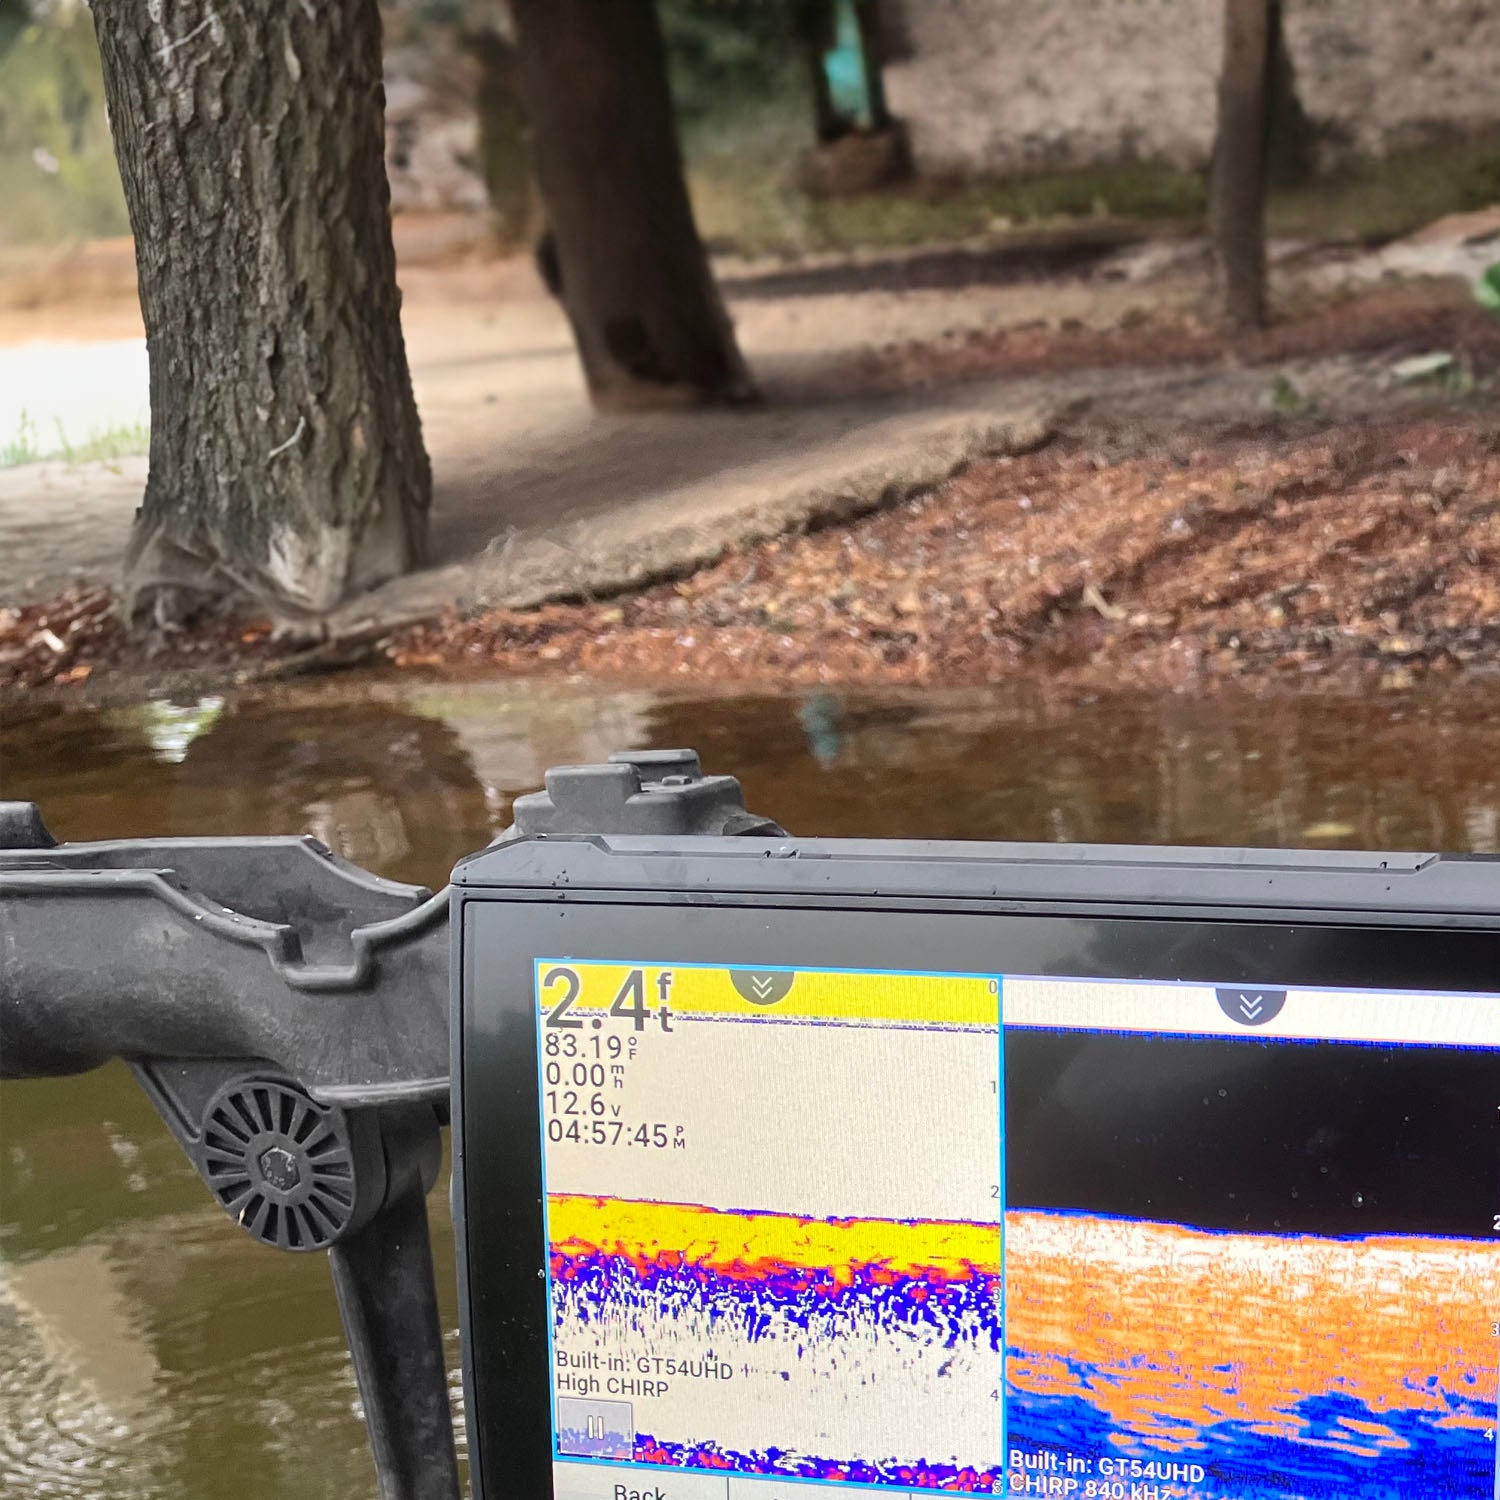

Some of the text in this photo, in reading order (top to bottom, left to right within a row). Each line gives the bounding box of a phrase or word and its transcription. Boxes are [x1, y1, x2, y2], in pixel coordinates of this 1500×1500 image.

[543, 966, 652, 1033] 2.4
[545, 1034, 622, 1060] 83.19
[546, 1062, 605, 1088] 0.00
[546, 1091, 605, 1116] 12.6
[548, 1119, 668, 1148] 04:57:45
[556, 1351, 733, 1381] Built-in: GT54UHD
[557, 1373, 669, 1398] High CHIRP
[1009, 1450, 1205, 1484] Built-in: GT54UHD
[1009, 1476, 1078, 1497] CHIRP
[1085, 1481, 1125, 1500] 840
